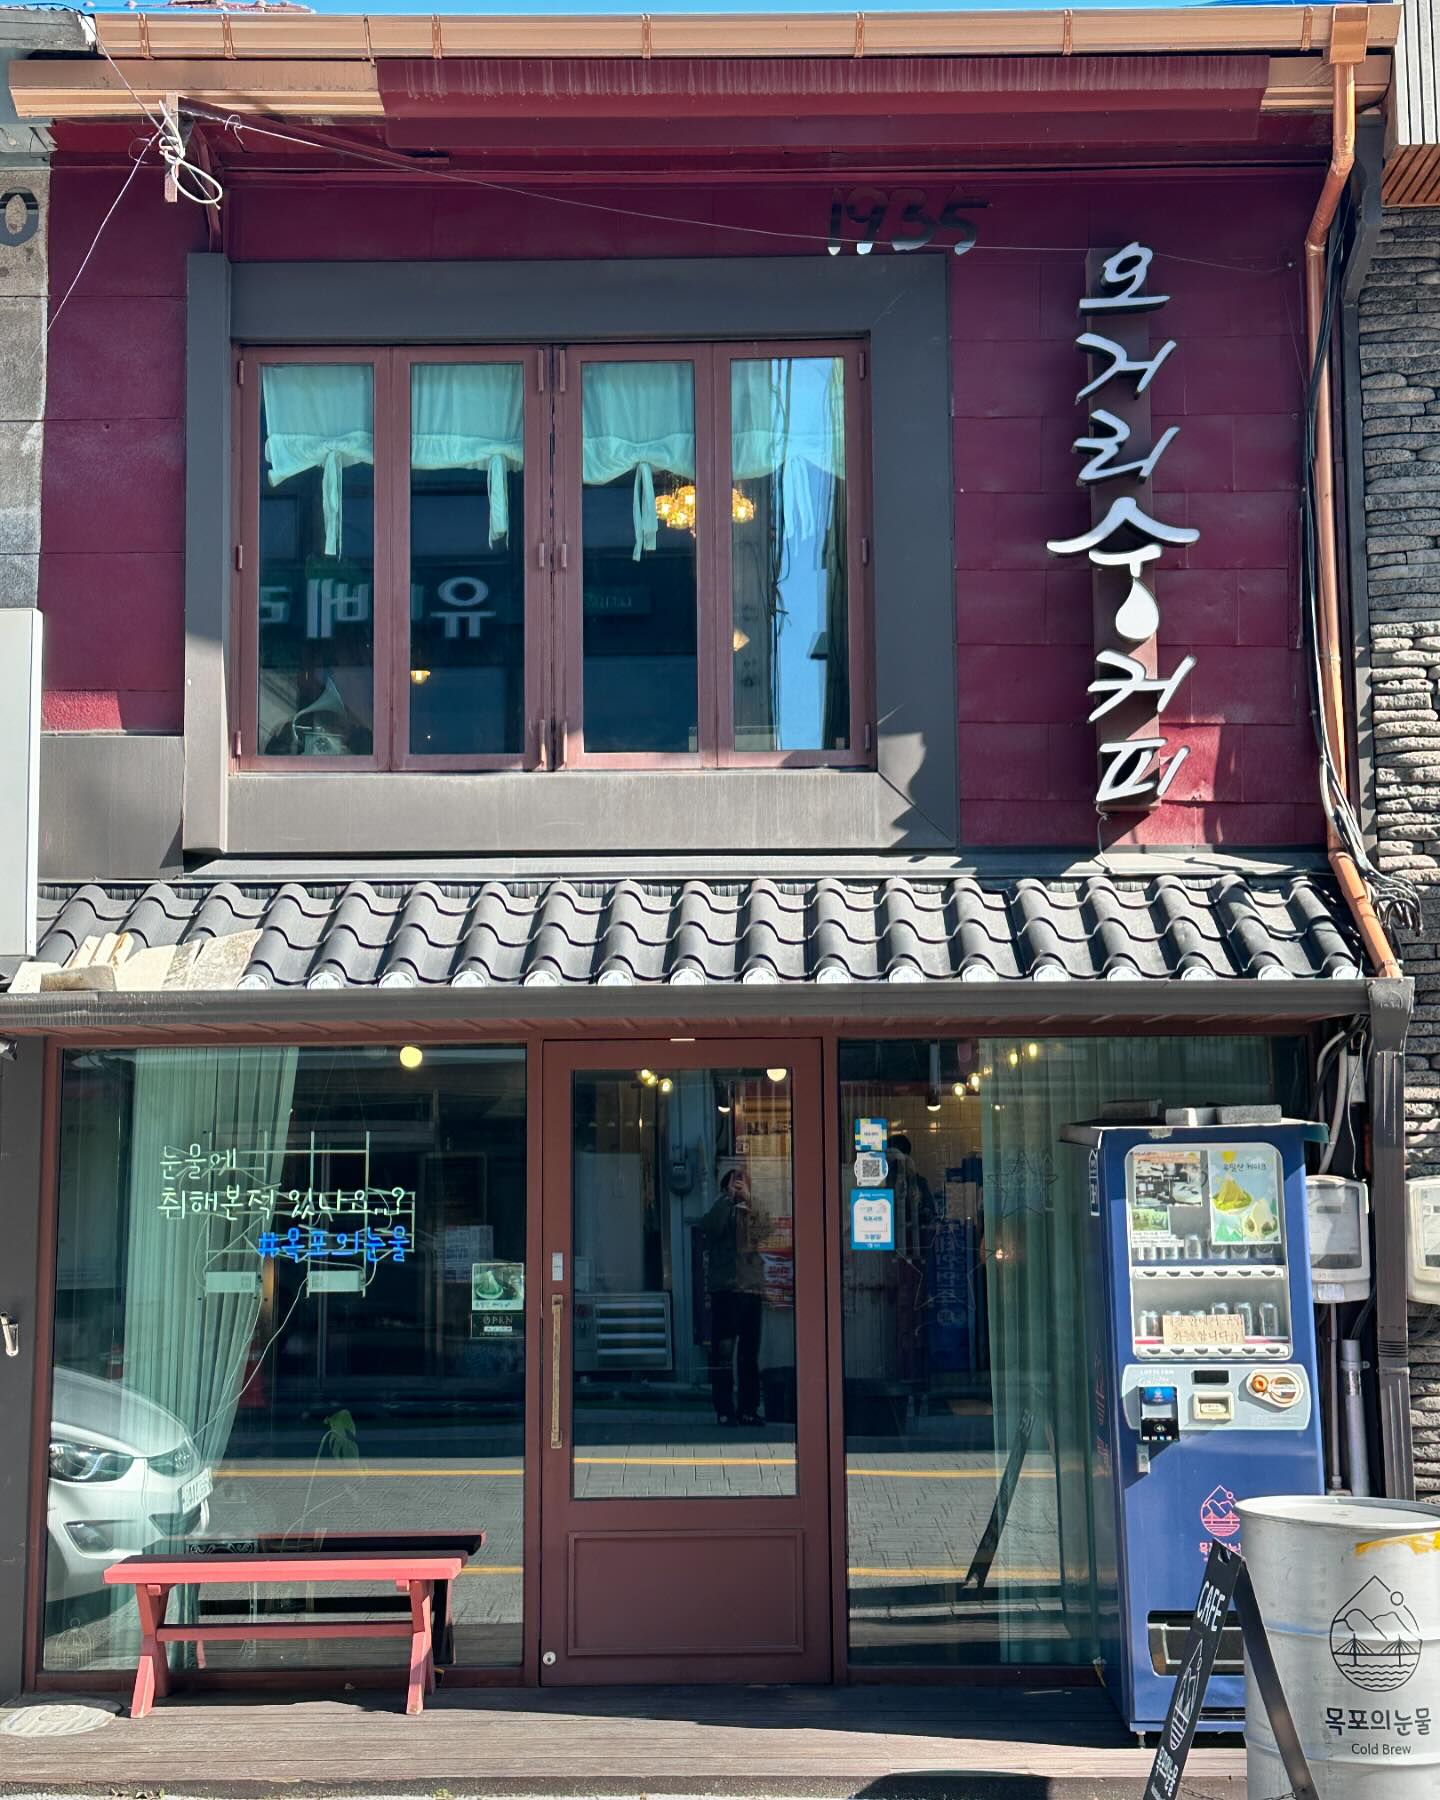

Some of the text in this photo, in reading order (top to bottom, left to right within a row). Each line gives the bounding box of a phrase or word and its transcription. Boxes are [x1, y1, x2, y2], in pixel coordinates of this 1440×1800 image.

[827, 186, 992, 256] 1935
[159, 1143, 237, 1180] 눈물에
[1196, 1580, 1226, 1632] CAFE
[1325, 1707, 1432, 1737] 목포의눈물
[1351, 1743, 1412, 1755] Cold Brew
